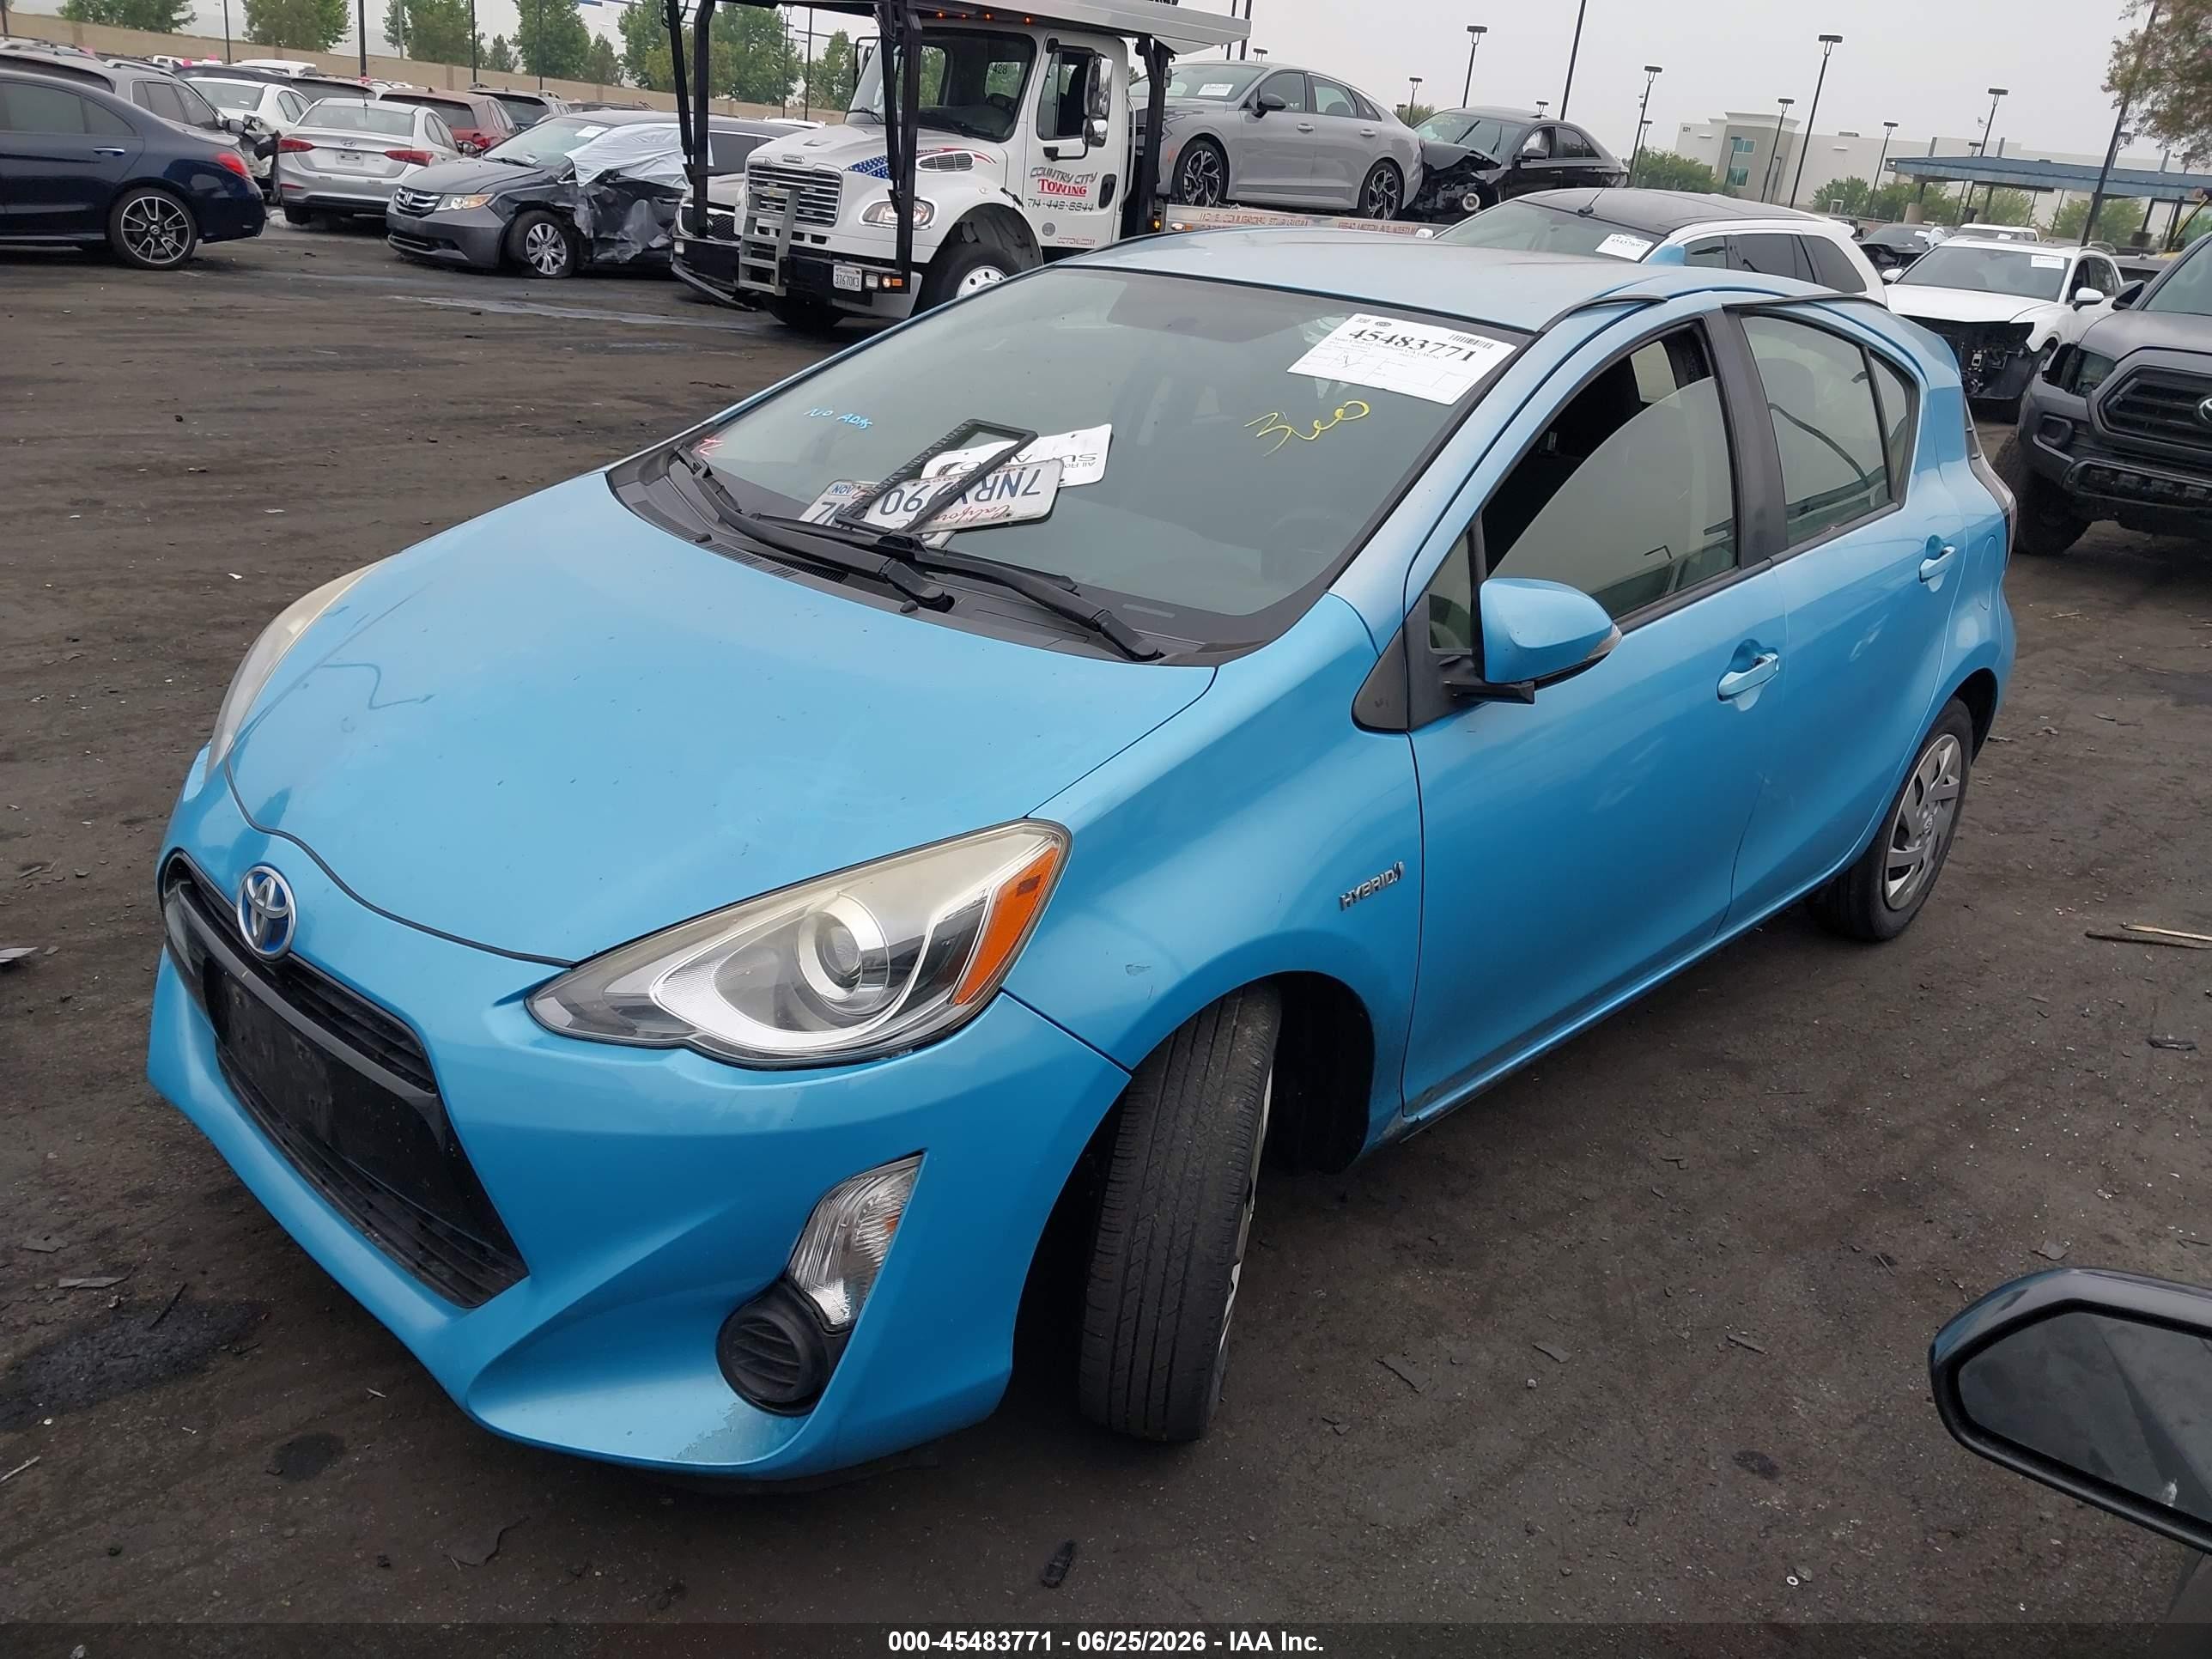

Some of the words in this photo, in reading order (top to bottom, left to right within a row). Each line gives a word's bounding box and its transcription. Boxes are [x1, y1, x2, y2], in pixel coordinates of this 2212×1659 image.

[1030, 167, 1074, 183] COUNTRY
[1074, 172, 1098, 185] CITY
[1037, 179, 1087, 195] TOWING
[1348, 329, 1477, 362] 45483771
[832, 484, 852, 495] NOV
[880, 469, 1041, 515] 7NR90
[1340, 868, 1396, 911] HYBRID
